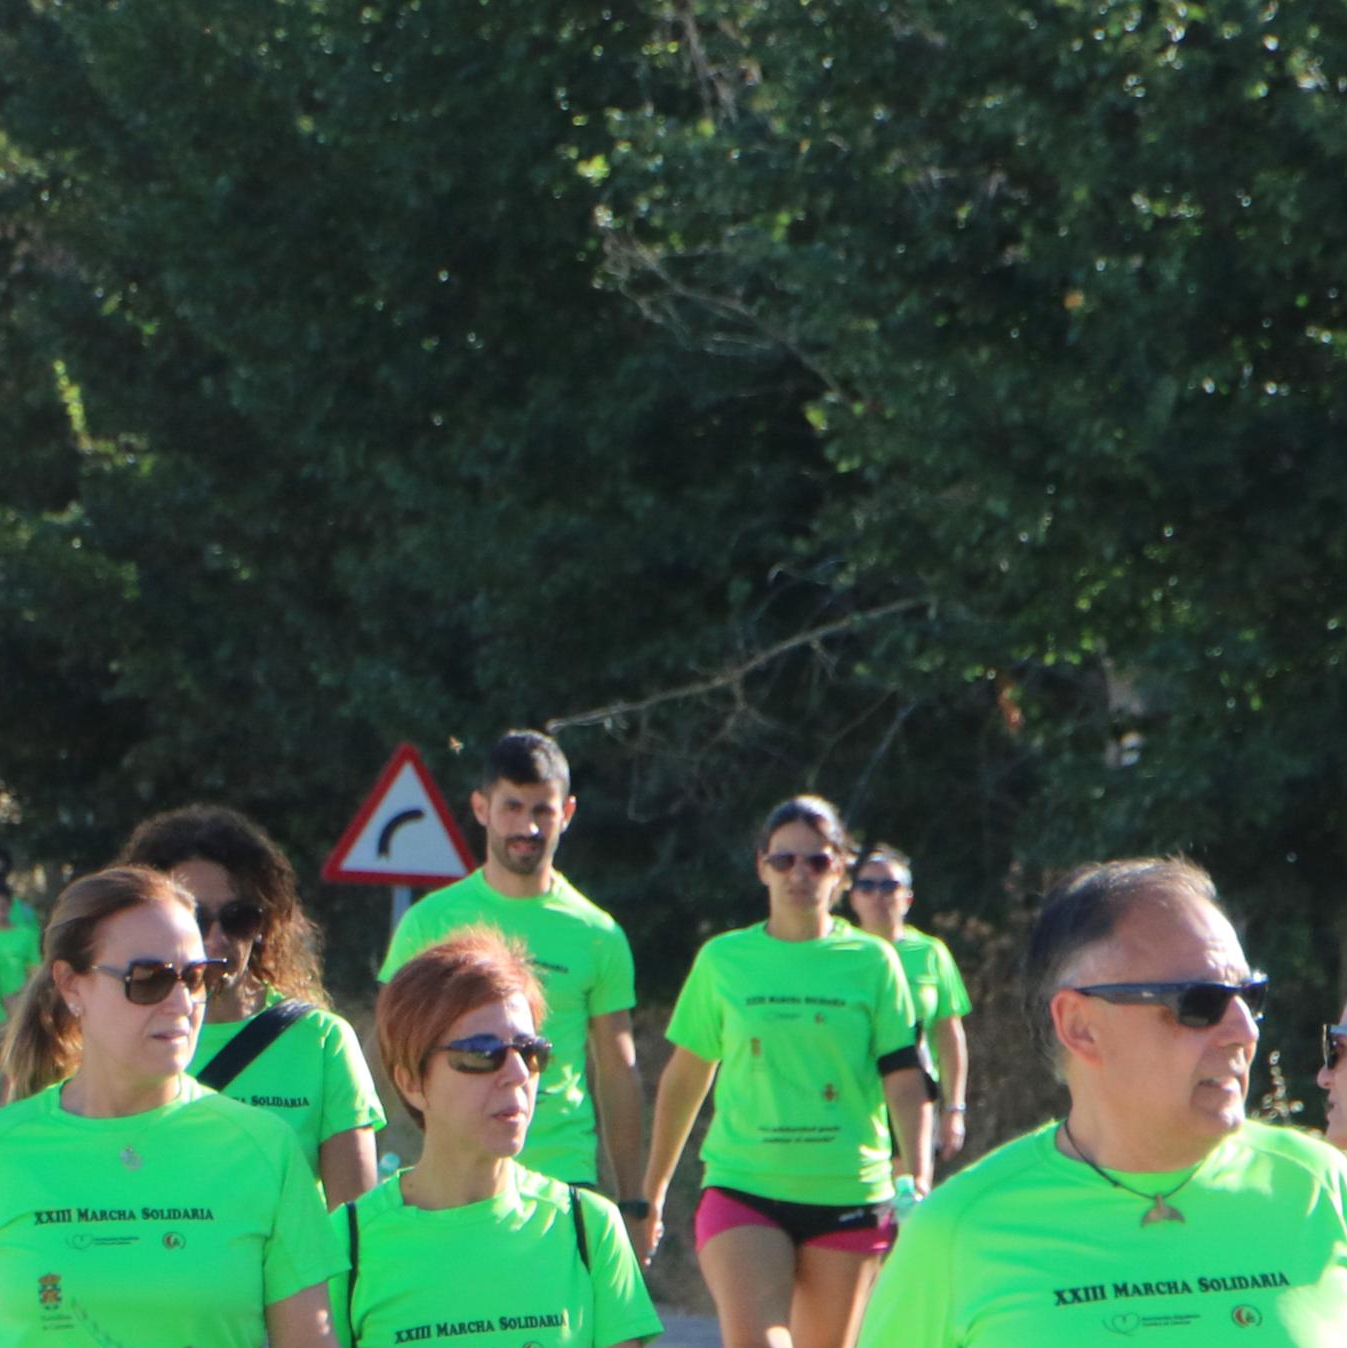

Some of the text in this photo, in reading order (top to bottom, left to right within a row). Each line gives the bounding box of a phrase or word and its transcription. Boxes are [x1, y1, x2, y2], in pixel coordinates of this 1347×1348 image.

[251, 1095, 310, 1107] SOLIDARIA
[34, 1207, 214, 1226] XXIII MARCHA SOLIDARIA
[1053, 1271, 1291, 1307] XXIII MARCHA SOLIDARIA
[395, 1314, 567, 1344] XXIII MARCHA SOLIDARIA
